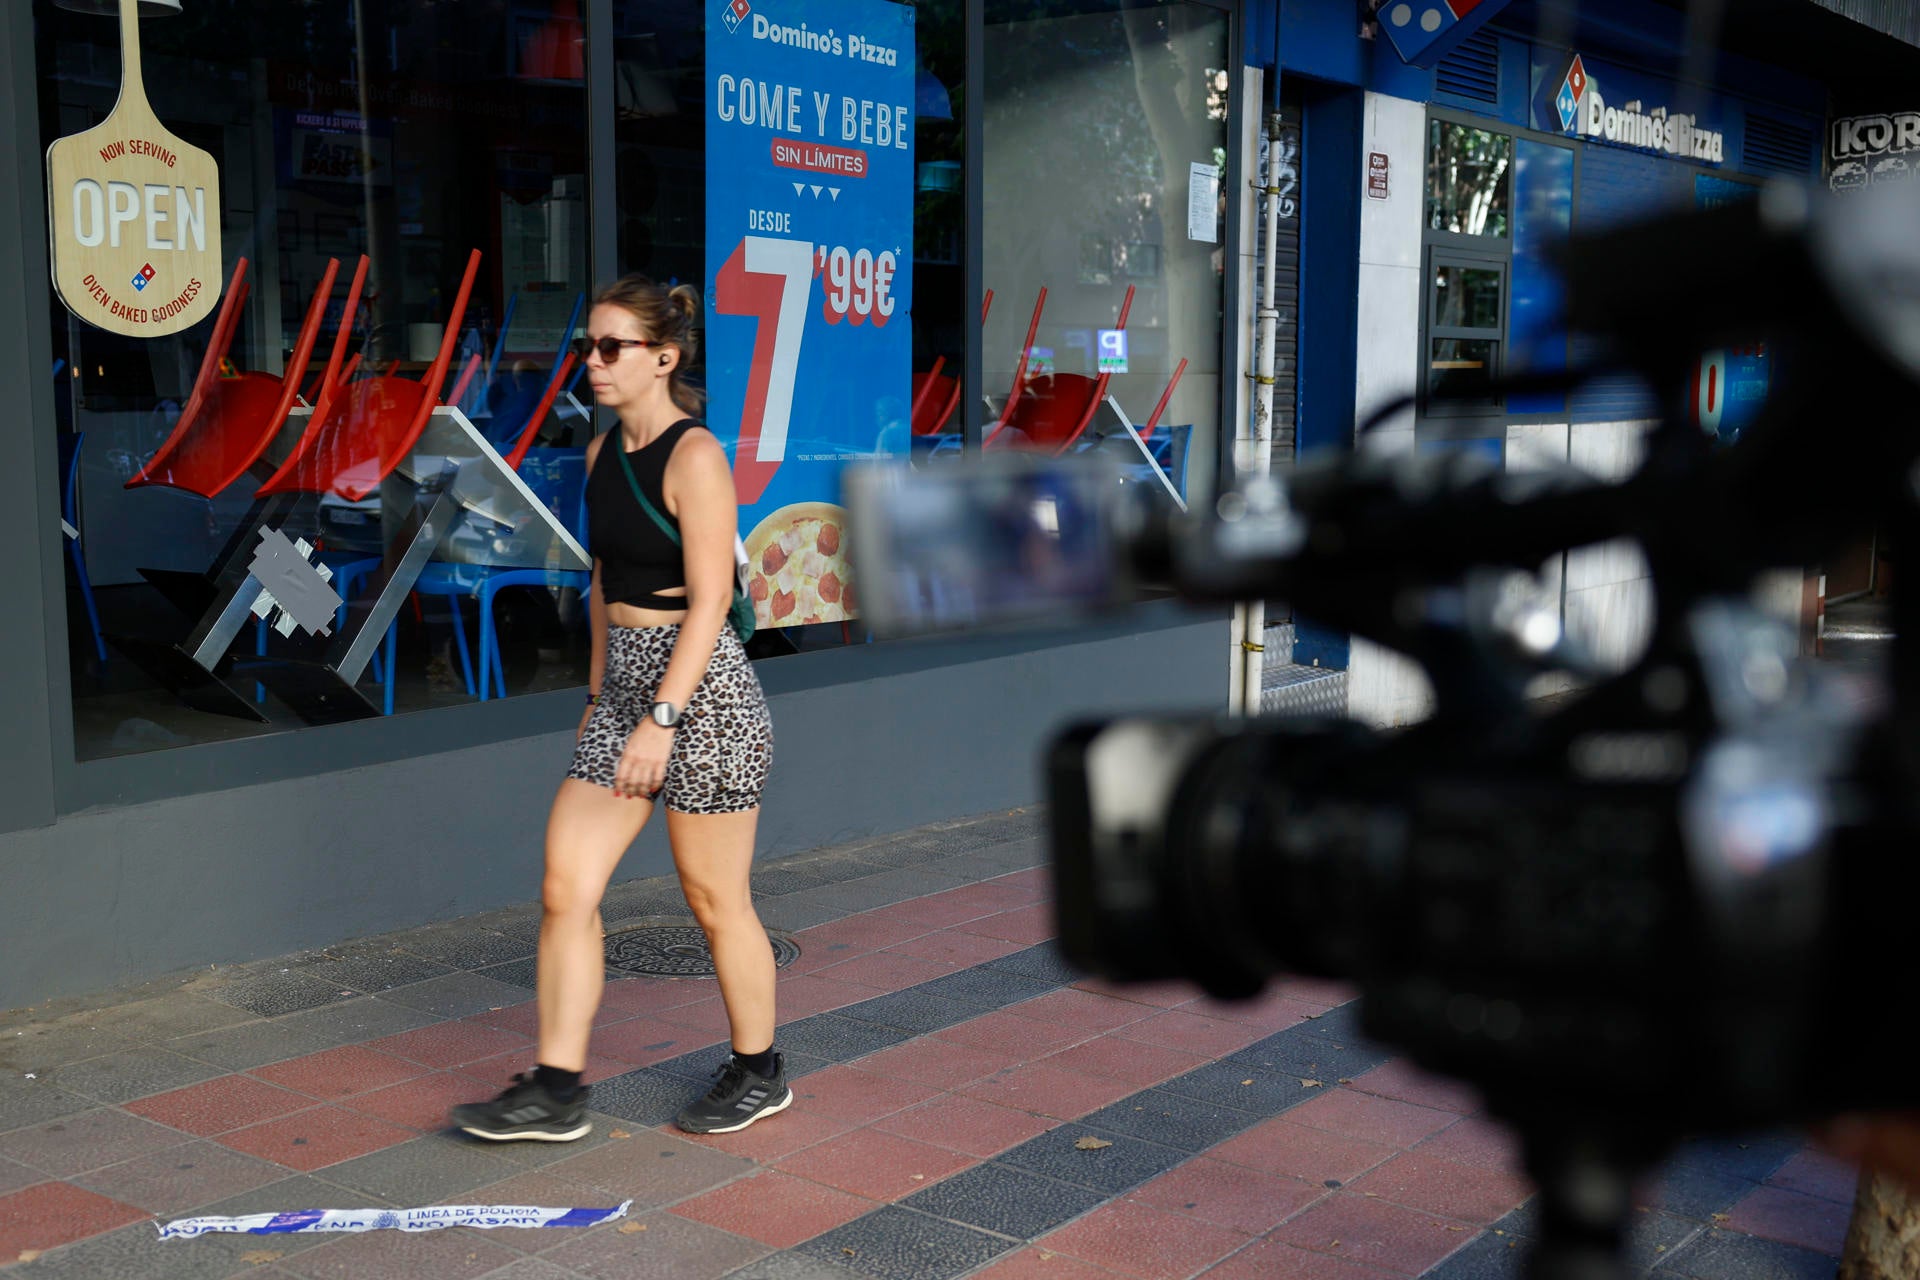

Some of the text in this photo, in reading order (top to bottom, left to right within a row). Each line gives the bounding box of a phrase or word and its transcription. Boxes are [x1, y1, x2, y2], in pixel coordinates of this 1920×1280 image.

[752, 13, 897, 67] Domino's Pizza
[717, 73, 908, 150] COME Y BEBE
[1577, 90, 1724, 163] Domino's Pizza
[99, 139, 177, 168] NOW SERVING
[775, 145, 863, 173] SIN LÍMITES
[72, 177, 205, 252] OPEN
[749, 208, 791, 233] DESDE
[83, 274, 202, 323] OVEN BAKED GOODNESS
[407, 1209, 450, 1220] LINEA
[455, 1208, 475, 1216] DE
[407, 1220, 444, 1229] NO
